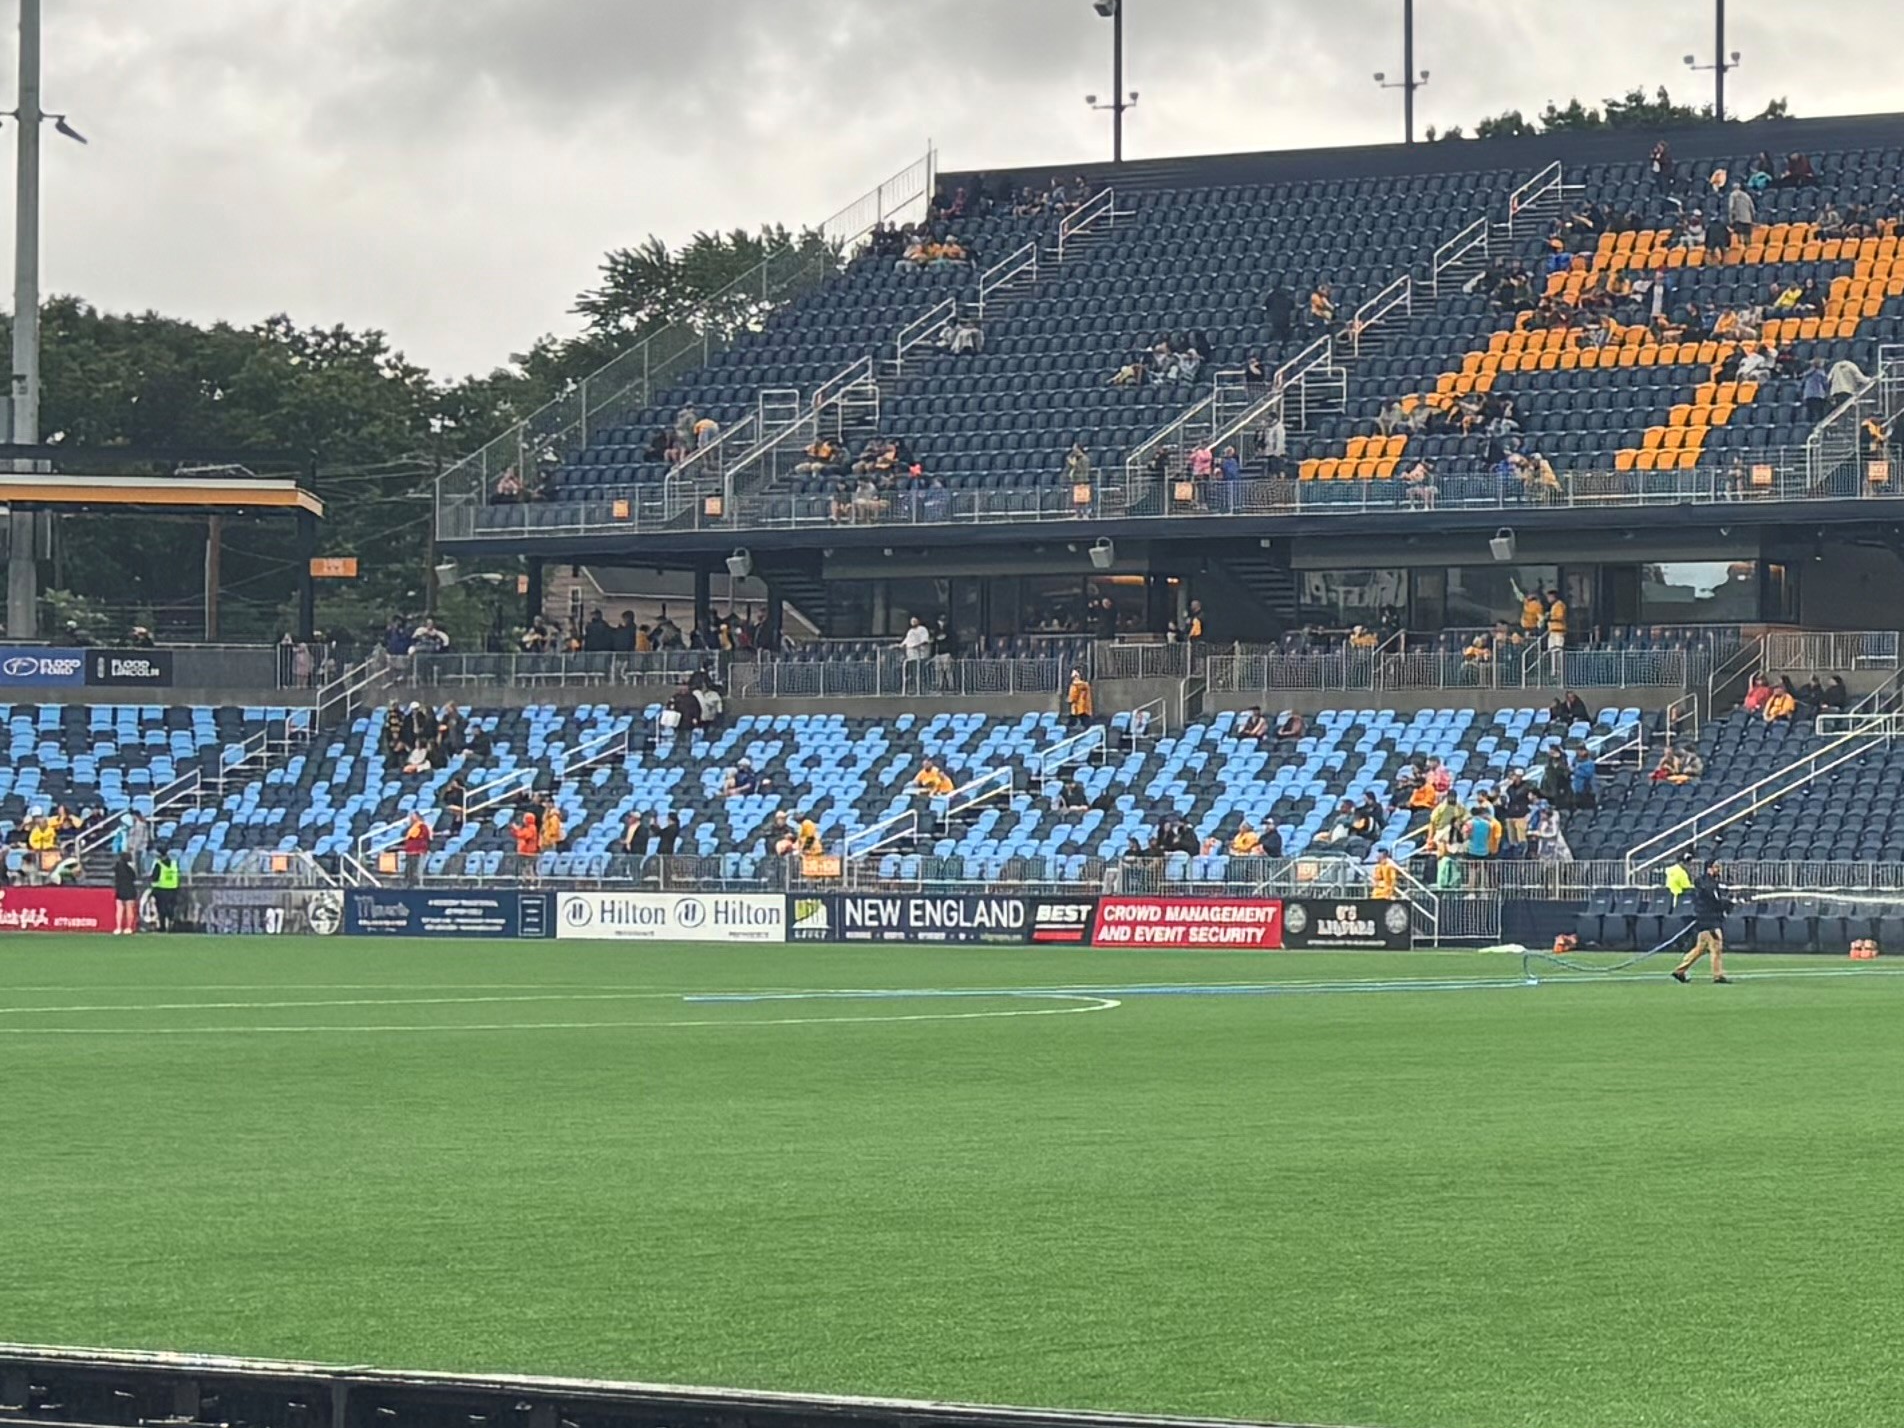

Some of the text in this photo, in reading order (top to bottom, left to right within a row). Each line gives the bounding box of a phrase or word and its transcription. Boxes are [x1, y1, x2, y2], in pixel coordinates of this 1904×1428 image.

[40, 659, 81, 667] FLOOD
[601, 899, 665, 925] Hilton
[714, 900, 780, 925] Hilton
[845, 898, 1024, 928] NEW ENGLAND
[1036, 904, 1092, 922] BEST
[1104, 905, 1277, 923] CROWD MANAGEMENT
[1098, 926, 1130, 942] AND
[1134, 926, 1186, 943] EVENT
[1188, 926, 1265, 943] SECURITY
